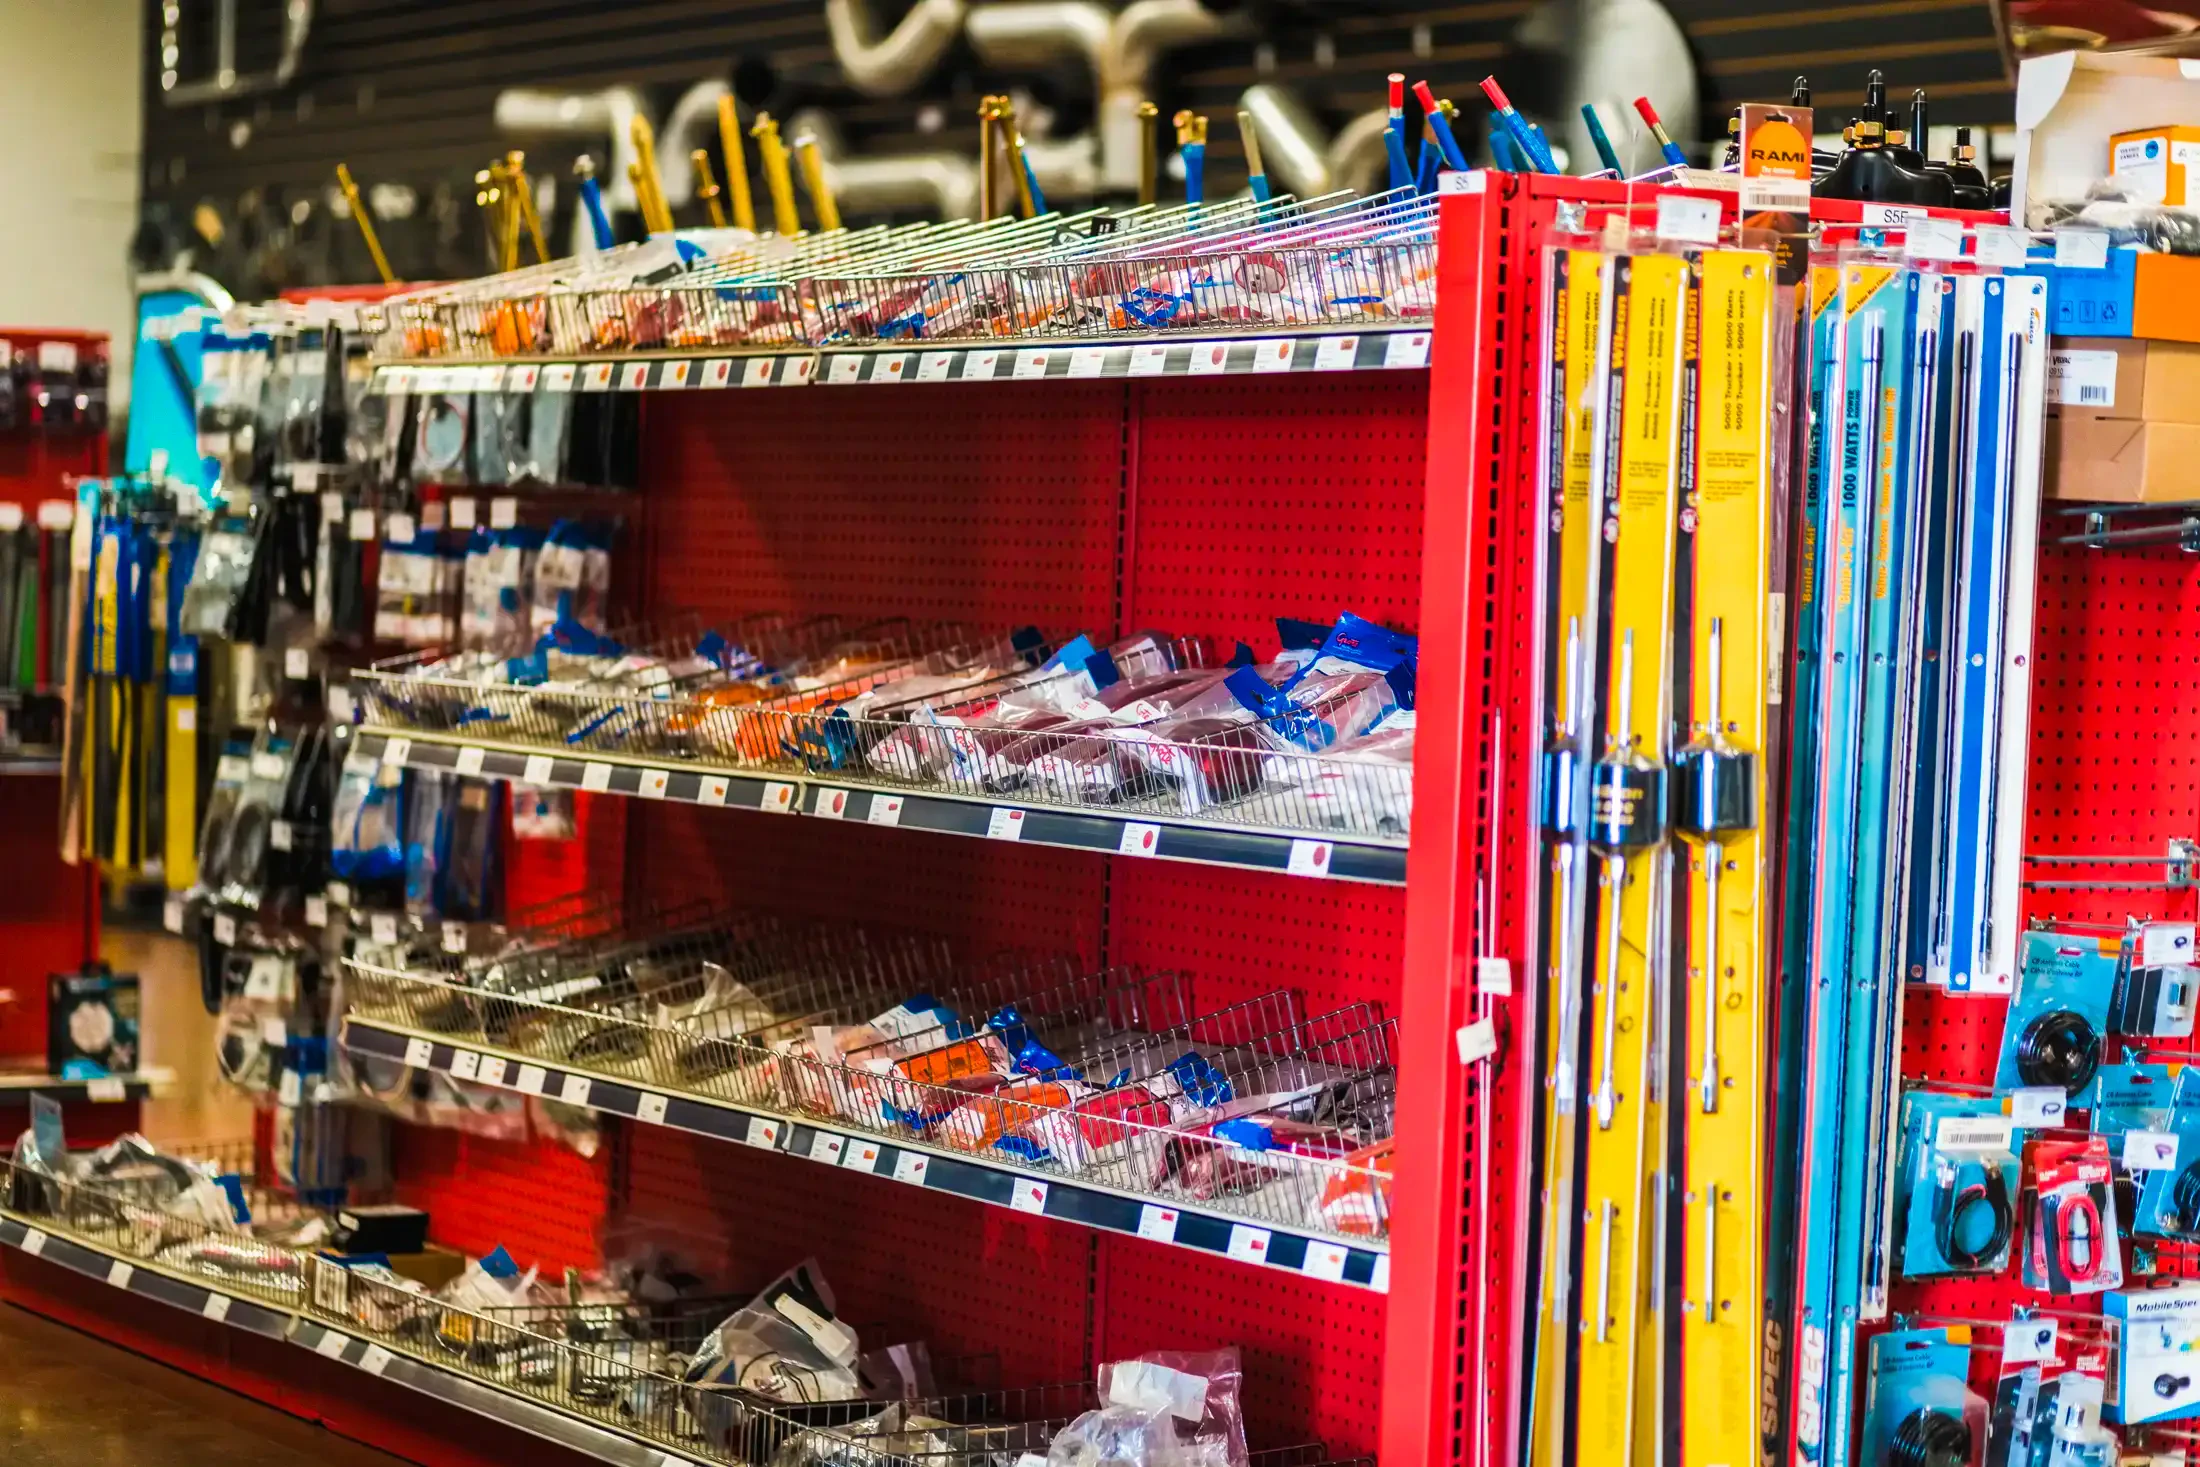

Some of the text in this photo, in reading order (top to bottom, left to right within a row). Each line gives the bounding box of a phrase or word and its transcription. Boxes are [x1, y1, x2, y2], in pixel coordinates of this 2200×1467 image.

[1751, 149, 1805, 162] RAMI
[1555, 289, 1567, 361] Wilson
[1684, 288, 1698, 360] Wilson
[1846, 390, 1854, 418] POWER
[1808, 474, 1818, 508] 1000
[1843, 422, 1860, 508] 1000 WATTS
[2117, 978, 2125, 1010] TRUCK
[1762, 1319, 1782, 1438] SPEC
[1800, 1325, 1825, 1444] SPEC
